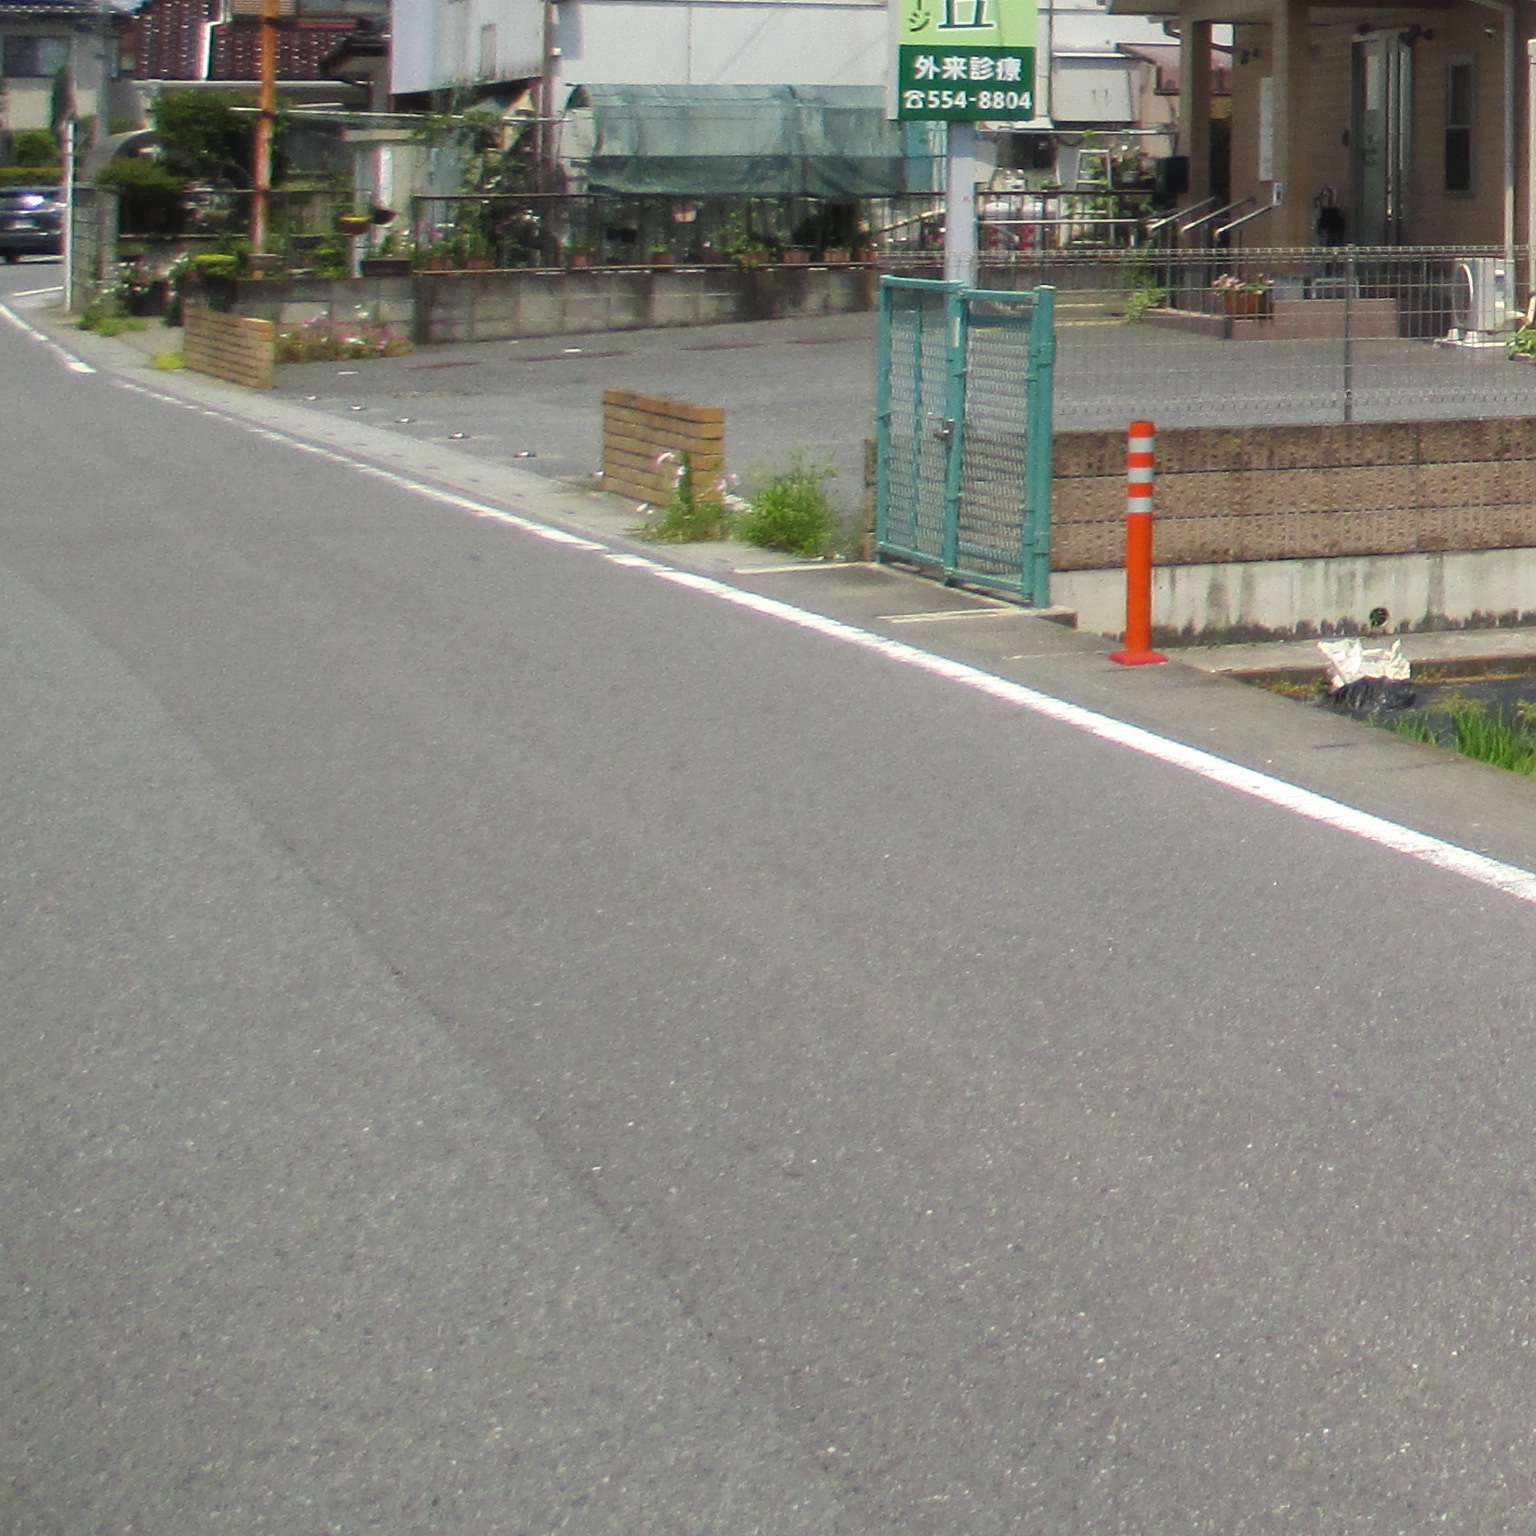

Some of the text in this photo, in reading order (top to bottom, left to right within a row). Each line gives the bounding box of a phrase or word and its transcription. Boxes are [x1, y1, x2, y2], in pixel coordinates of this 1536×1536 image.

[914, 55, 1022, 82] 外来診療
[927, 90, 1032, 110] 554-8804
